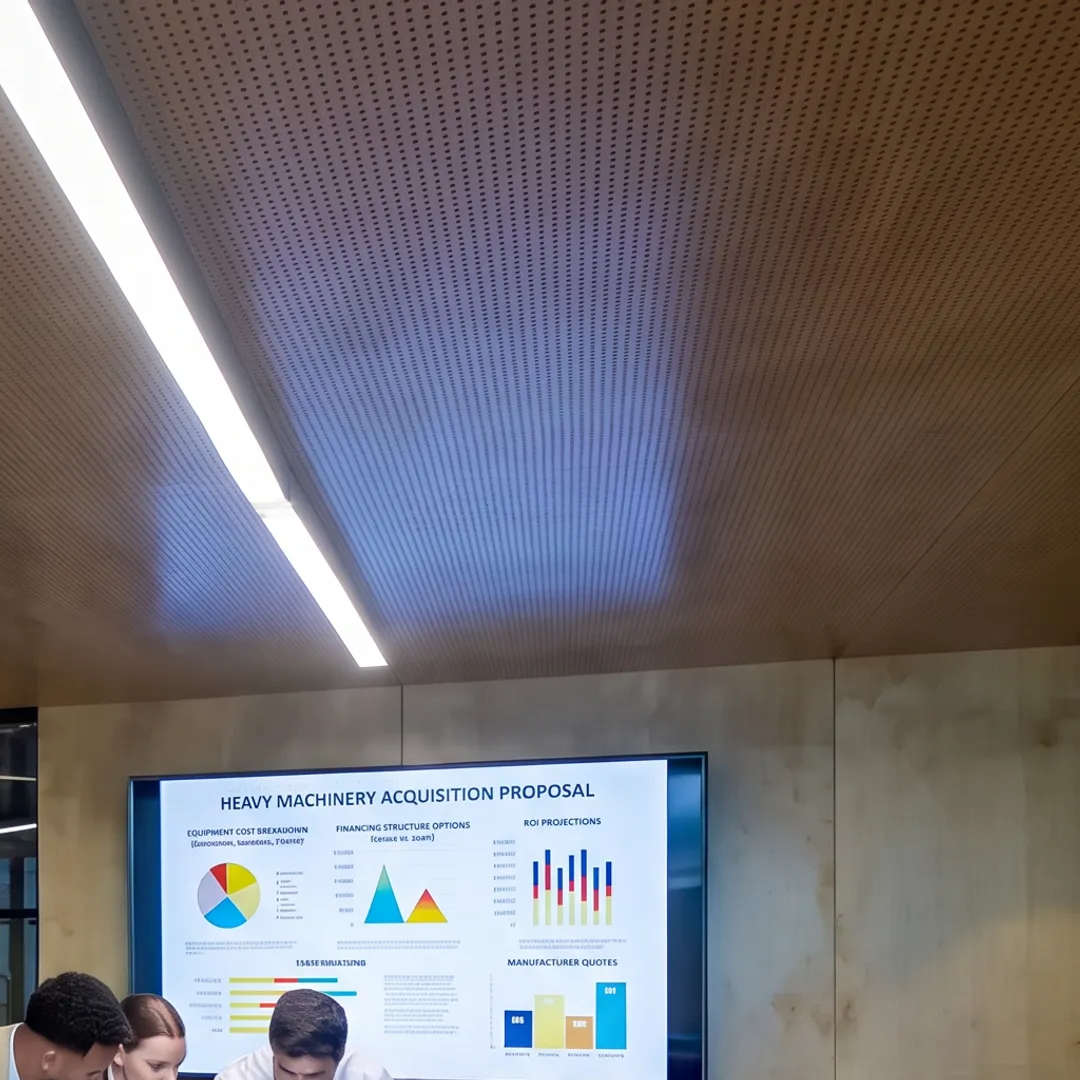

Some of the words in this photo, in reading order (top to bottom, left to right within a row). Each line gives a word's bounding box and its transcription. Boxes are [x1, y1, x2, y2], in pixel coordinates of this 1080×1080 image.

[220, 794, 273, 810] HEAVY
[276, 790, 377, 808] MACHINERY
[380, 786, 494, 806] ACQUISITION
[499, 783, 595, 801] PROPOSAL
[335, 824, 382, 833] FINANCING
[382, 822, 431, 832] STRUCTURE
[432, 821, 471, 831] OPTIONS
[523, 819, 540, 827] ROI
[541, 817, 602, 826] PROJECTIONS
[235, 828, 256, 836] COST
[507, 958, 580, 967] MANUFACTURER
[581, 958, 618, 968] QUOTES
